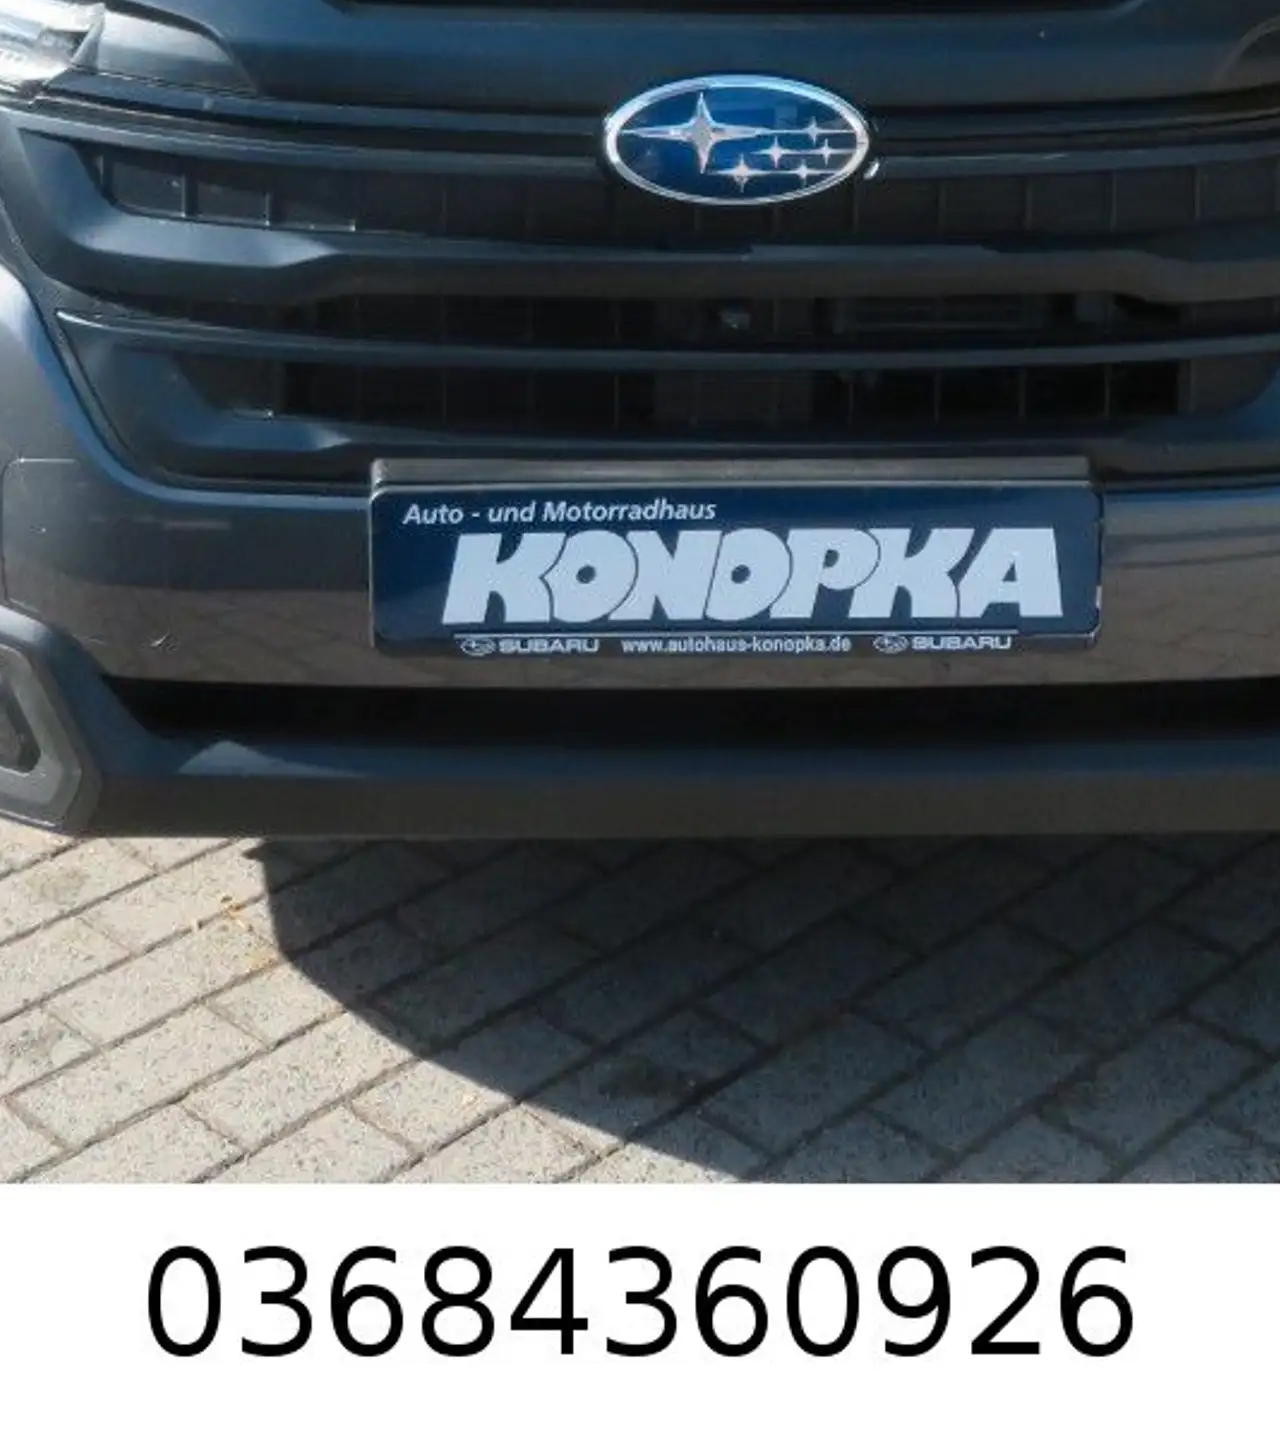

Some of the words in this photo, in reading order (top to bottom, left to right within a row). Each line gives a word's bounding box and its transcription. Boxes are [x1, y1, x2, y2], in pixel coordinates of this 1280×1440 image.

[402, 503, 464, 526] Auto
[487, 500, 536, 523] und
[541, 496, 718, 523] Motorradhaus
[442, 526, 1064, 626] KONOPKA
[498, 638, 601, 653] SUBARU
[621, 635, 852, 653] www.autohaus-konopka.de
[911, 635, 1012, 650] SUBARU
